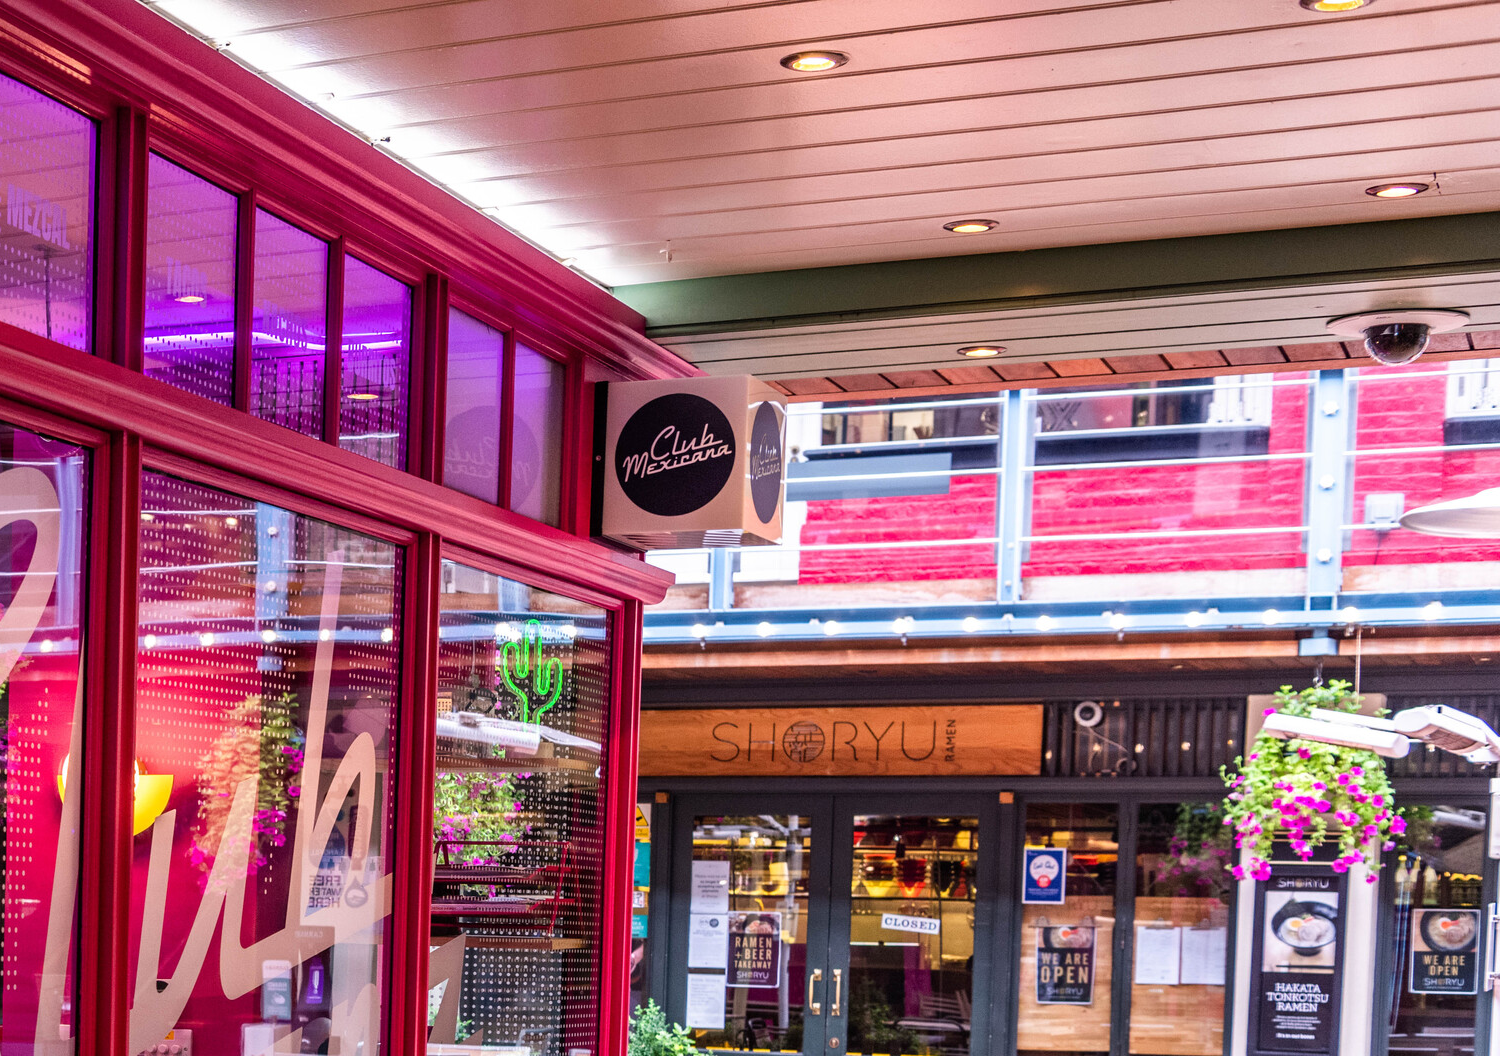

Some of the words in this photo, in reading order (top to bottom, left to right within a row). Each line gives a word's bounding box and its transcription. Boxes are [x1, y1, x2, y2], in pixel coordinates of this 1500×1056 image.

[7, 184, 71, 250] MEZCAL
[650, 423, 723, 461] Club
[622, 443, 732, 483] Mexicana
[710, 721, 937, 763] SHORYU
[944, 719, 957, 762] RAMEN
[1278, 878, 1329, 889] SHORYU
[884, 917, 937, 931] CLOSED
[735, 936, 772, 949] RAMEN
[744, 948, 772, 960] BEER
[1041, 952, 1059, 965] WE
[1065, 952, 1089, 965] ARE
[1423, 954, 1440, 966] WE
[1443, 955, 1466, 966] ARE
[734, 960, 772, 969] TAKEAWAY
[736, 971, 769, 979] SHORYU
[1040, 966, 1089, 984] OPEN
[1429, 966, 1459, 976] OPEN
[1275, 982, 1321, 993] HAKATA
[1265, 992, 1329, 1003] TONKOTSU
[1275, 1002, 1318, 1012] RAMEN
